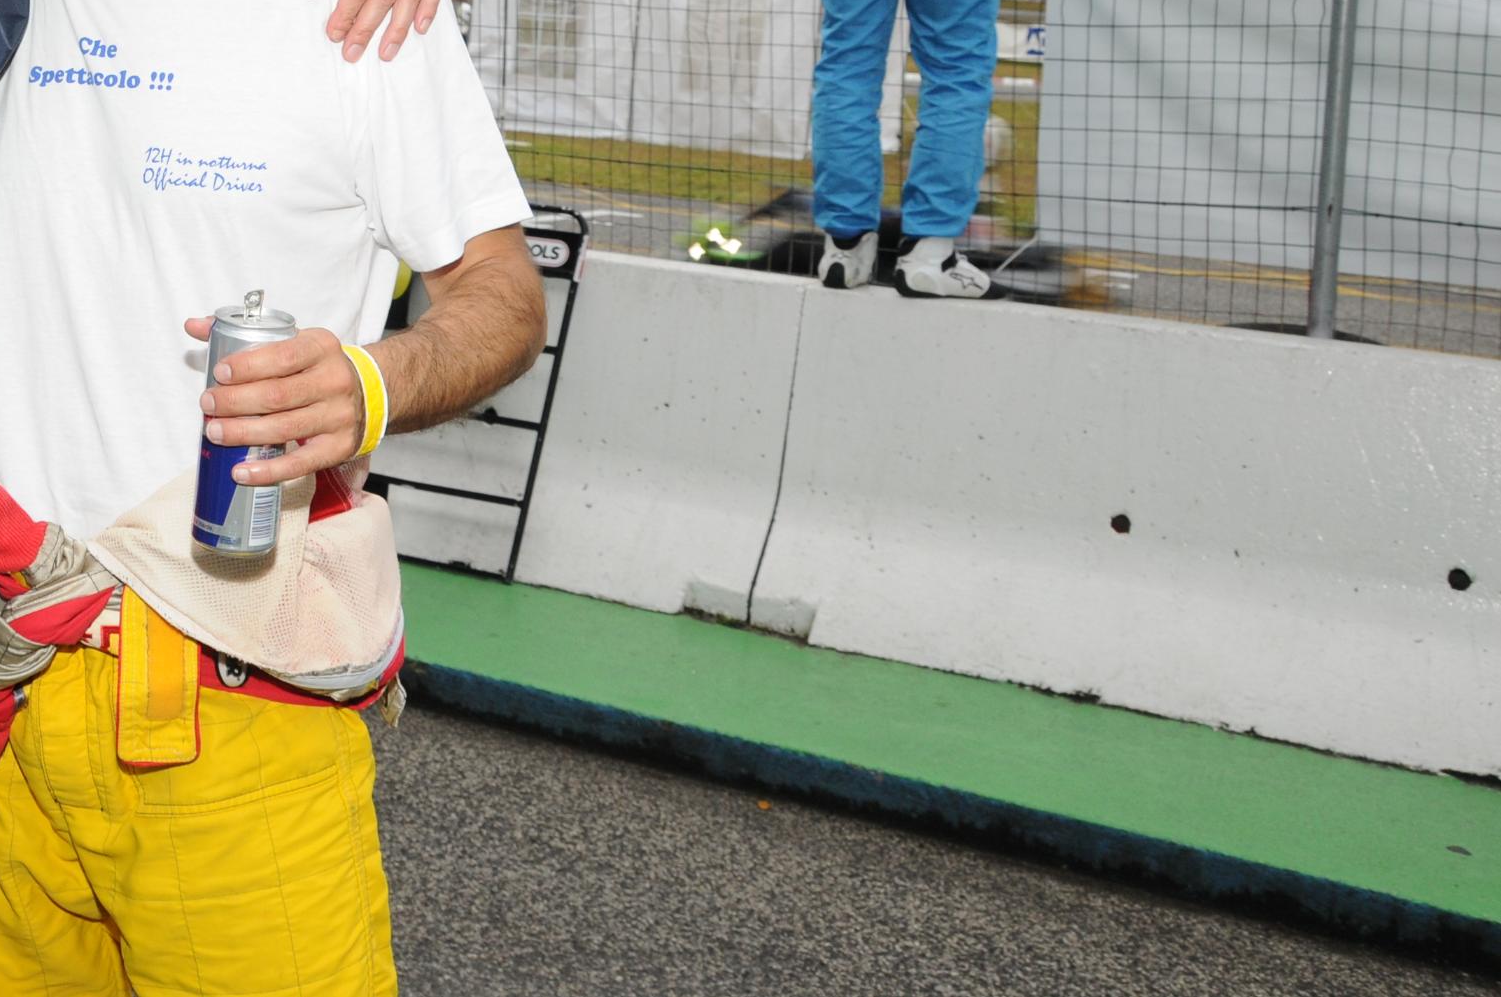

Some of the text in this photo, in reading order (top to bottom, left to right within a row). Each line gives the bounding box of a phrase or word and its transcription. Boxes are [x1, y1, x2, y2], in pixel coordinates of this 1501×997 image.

[78, 37, 117, 58] Che
[28, 66, 175, 91] Spettacolo !!!
[144, 147, 268, 171] 12H in notturna
[142, 167, 263, 192] Official Driver
